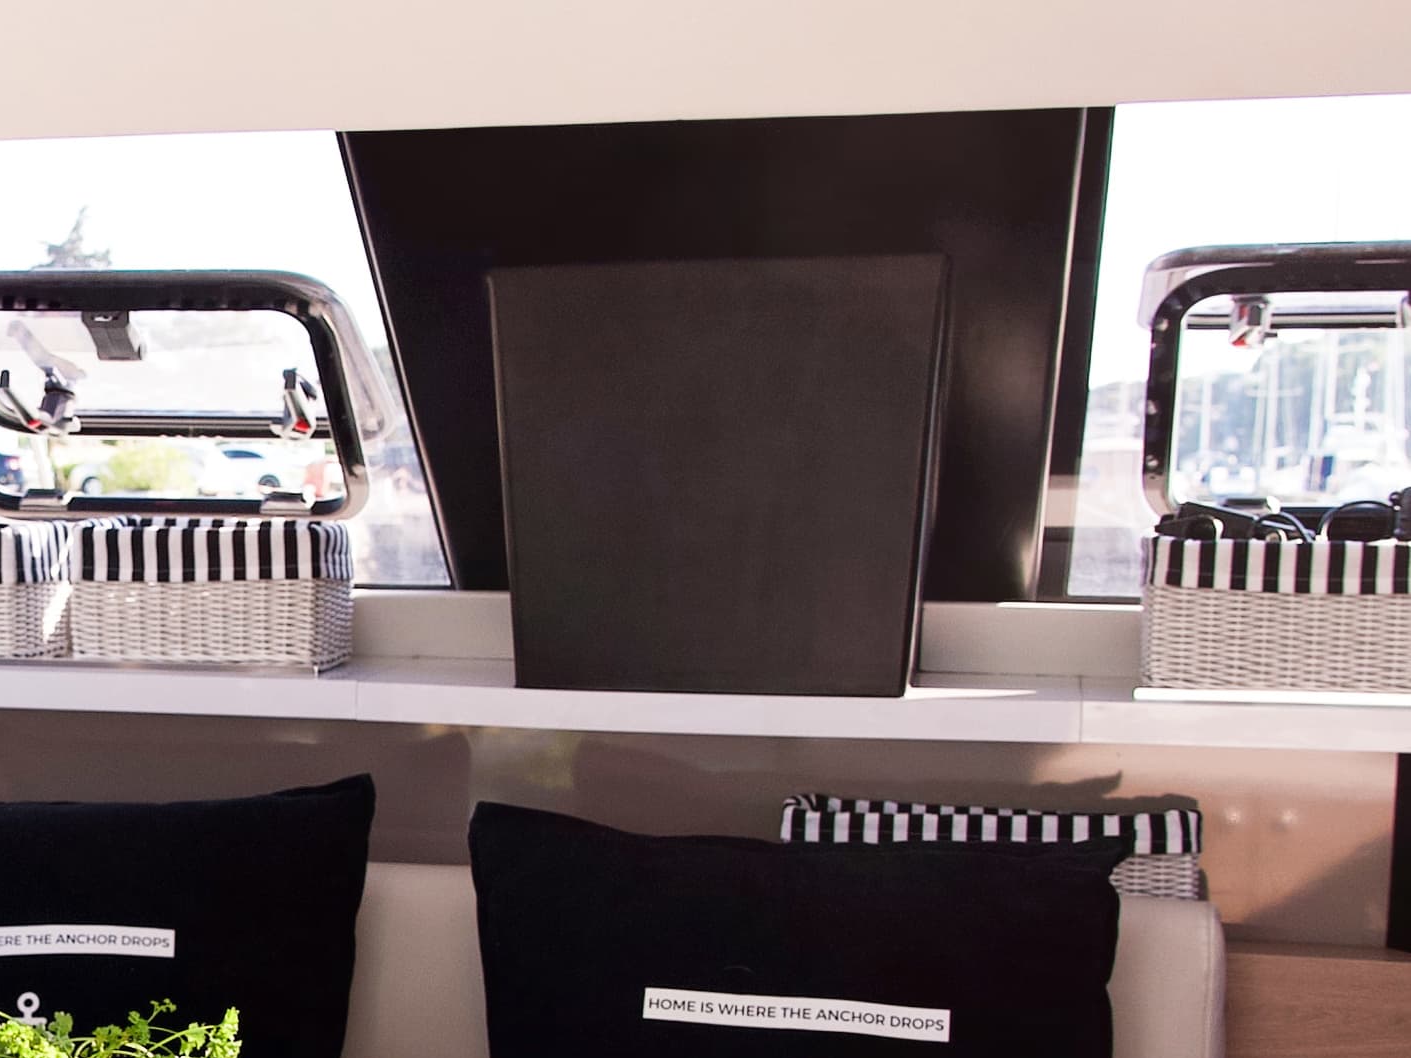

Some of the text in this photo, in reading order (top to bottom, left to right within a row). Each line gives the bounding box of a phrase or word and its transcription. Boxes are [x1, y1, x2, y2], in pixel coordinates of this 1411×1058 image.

[26, 934, 52, 946] THE
[55, 933, 118, 945] ANCHOR
[121, 935, 171, 948] DROPS
[648, 997, 946, 1032] HOME IS WHERE THE ANCHOR DROPS
